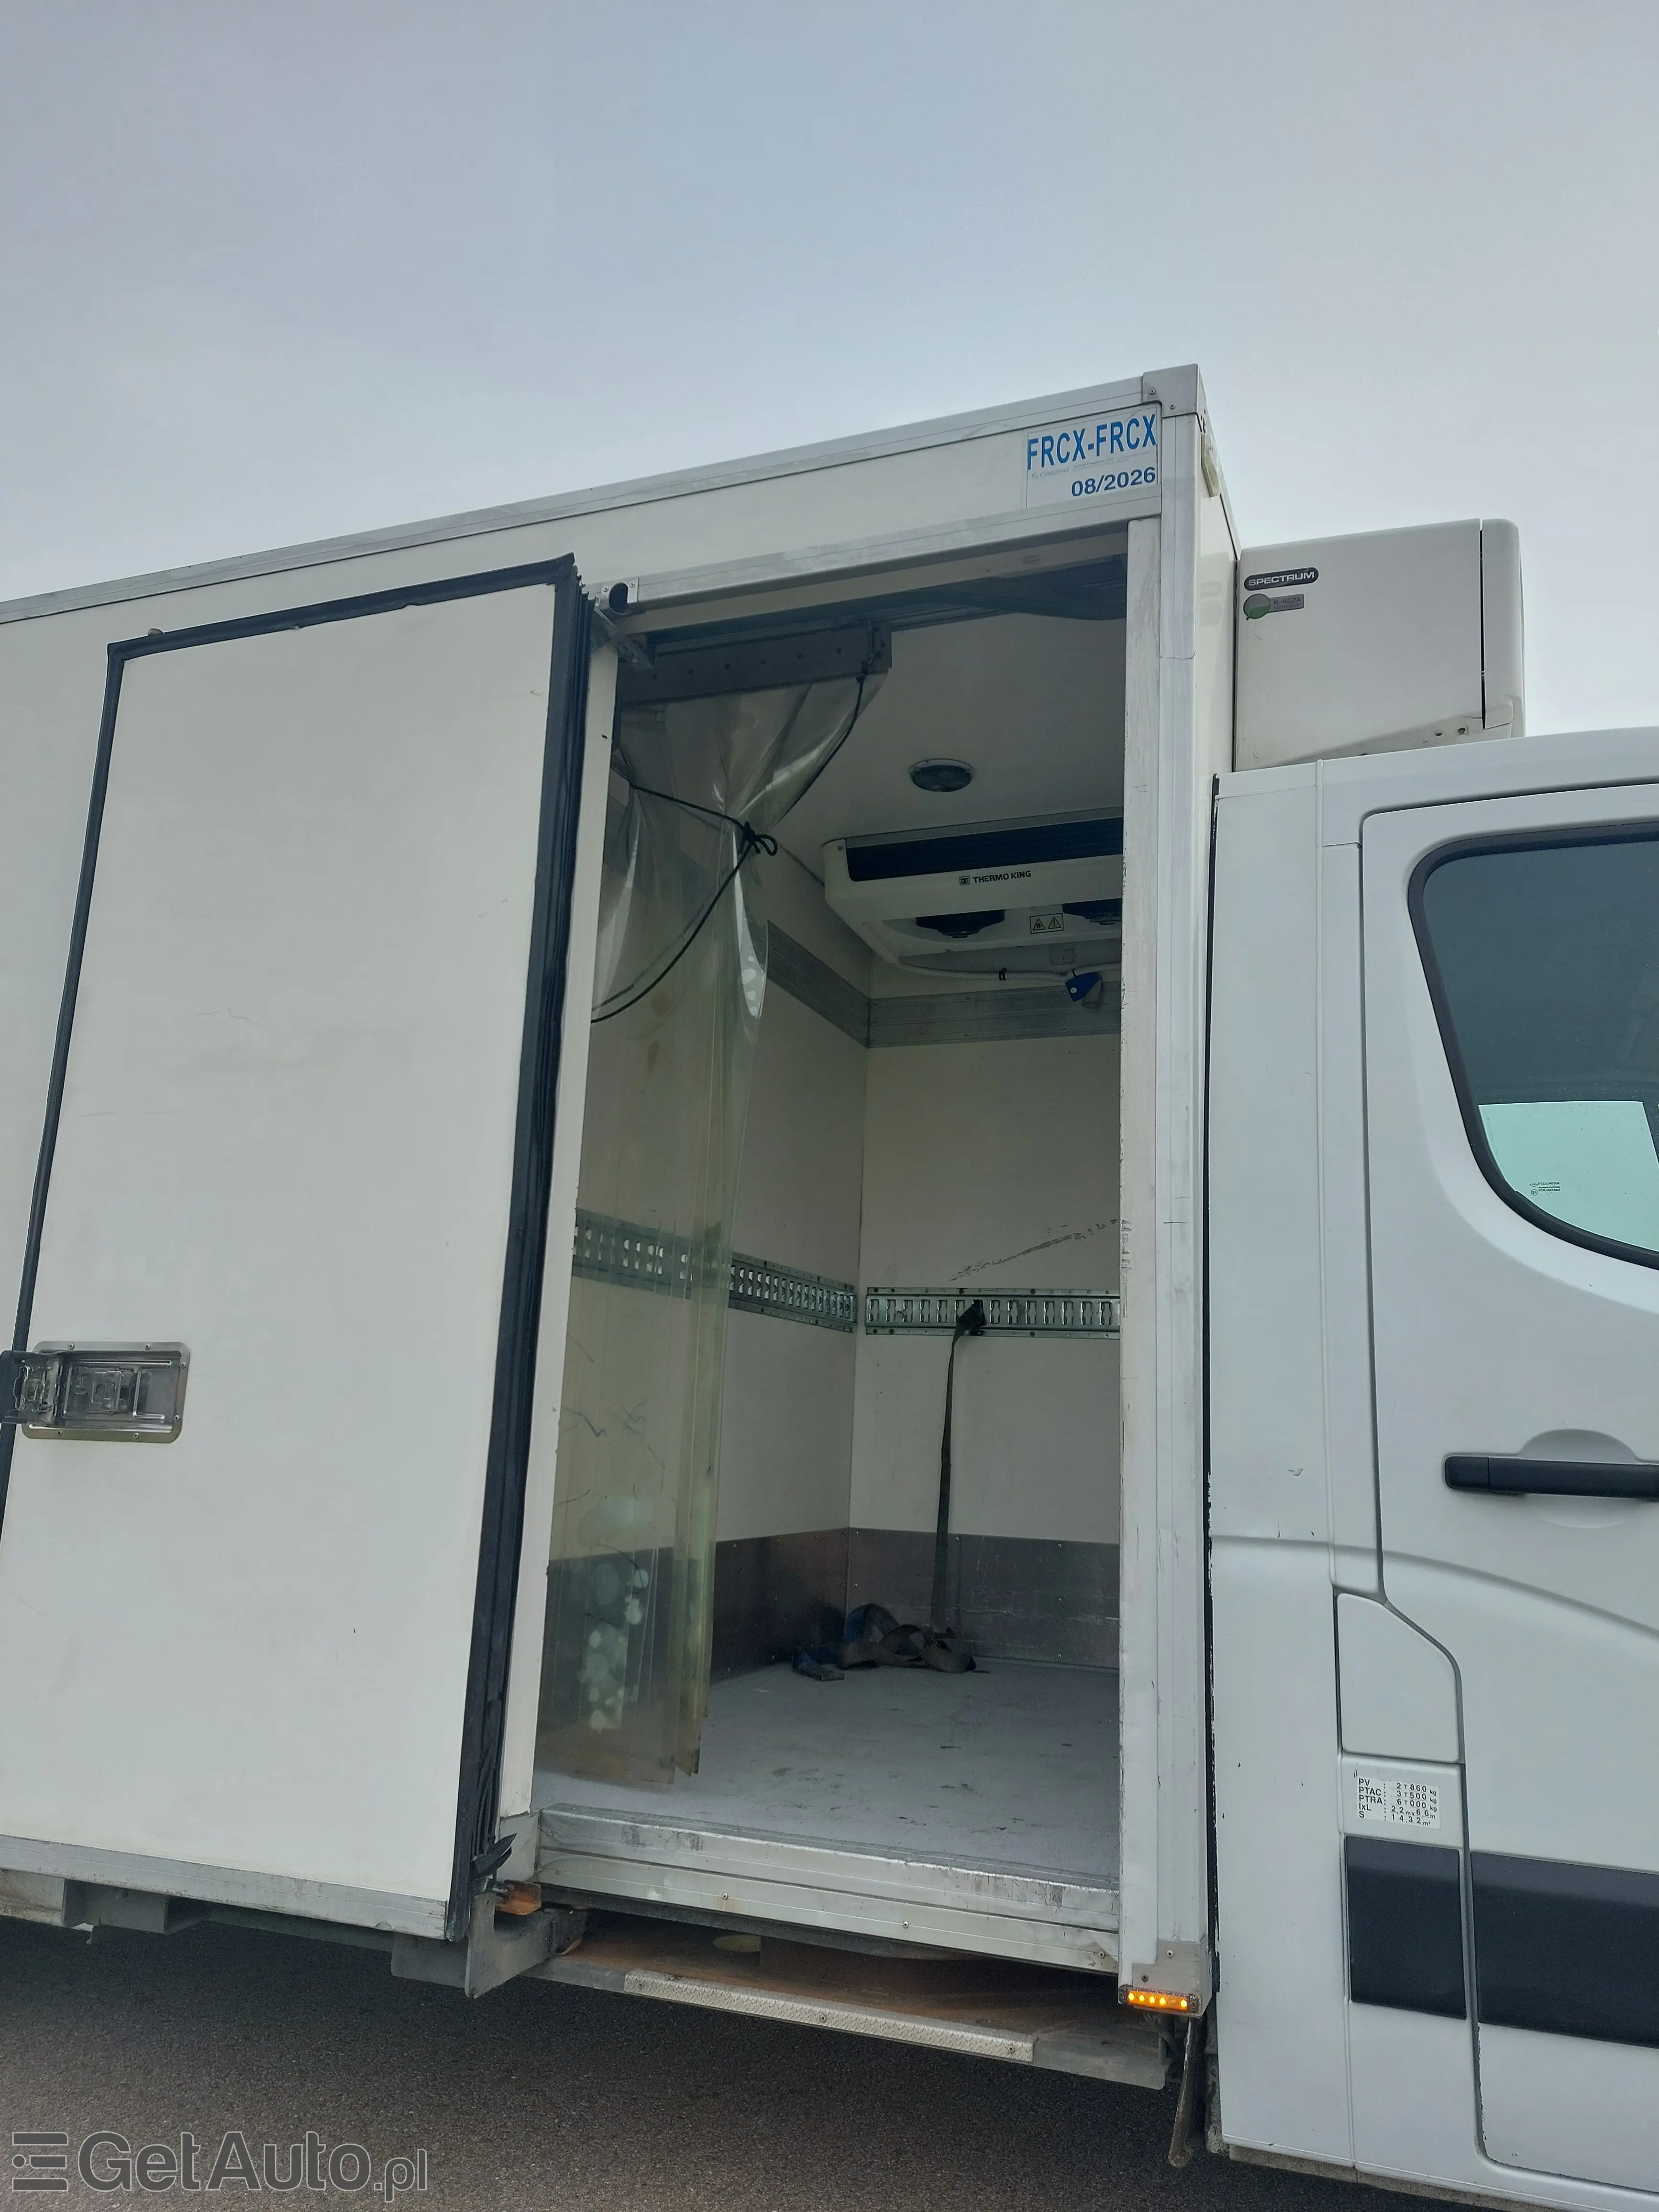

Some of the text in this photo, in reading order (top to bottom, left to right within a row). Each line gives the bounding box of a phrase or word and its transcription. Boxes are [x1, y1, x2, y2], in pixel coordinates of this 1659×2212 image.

[1028, 414, 1157, 470] FRCX-FRCX
[1071, 466, 1156, 497] 08/2026
[1248, 571, 1315, 586] SPECTRUM
[1274, 597, 1301, 606] R-452A
[973, 870, 1031, 884] THERMO KING
[1359, 1778, 1370, 1786] PV
